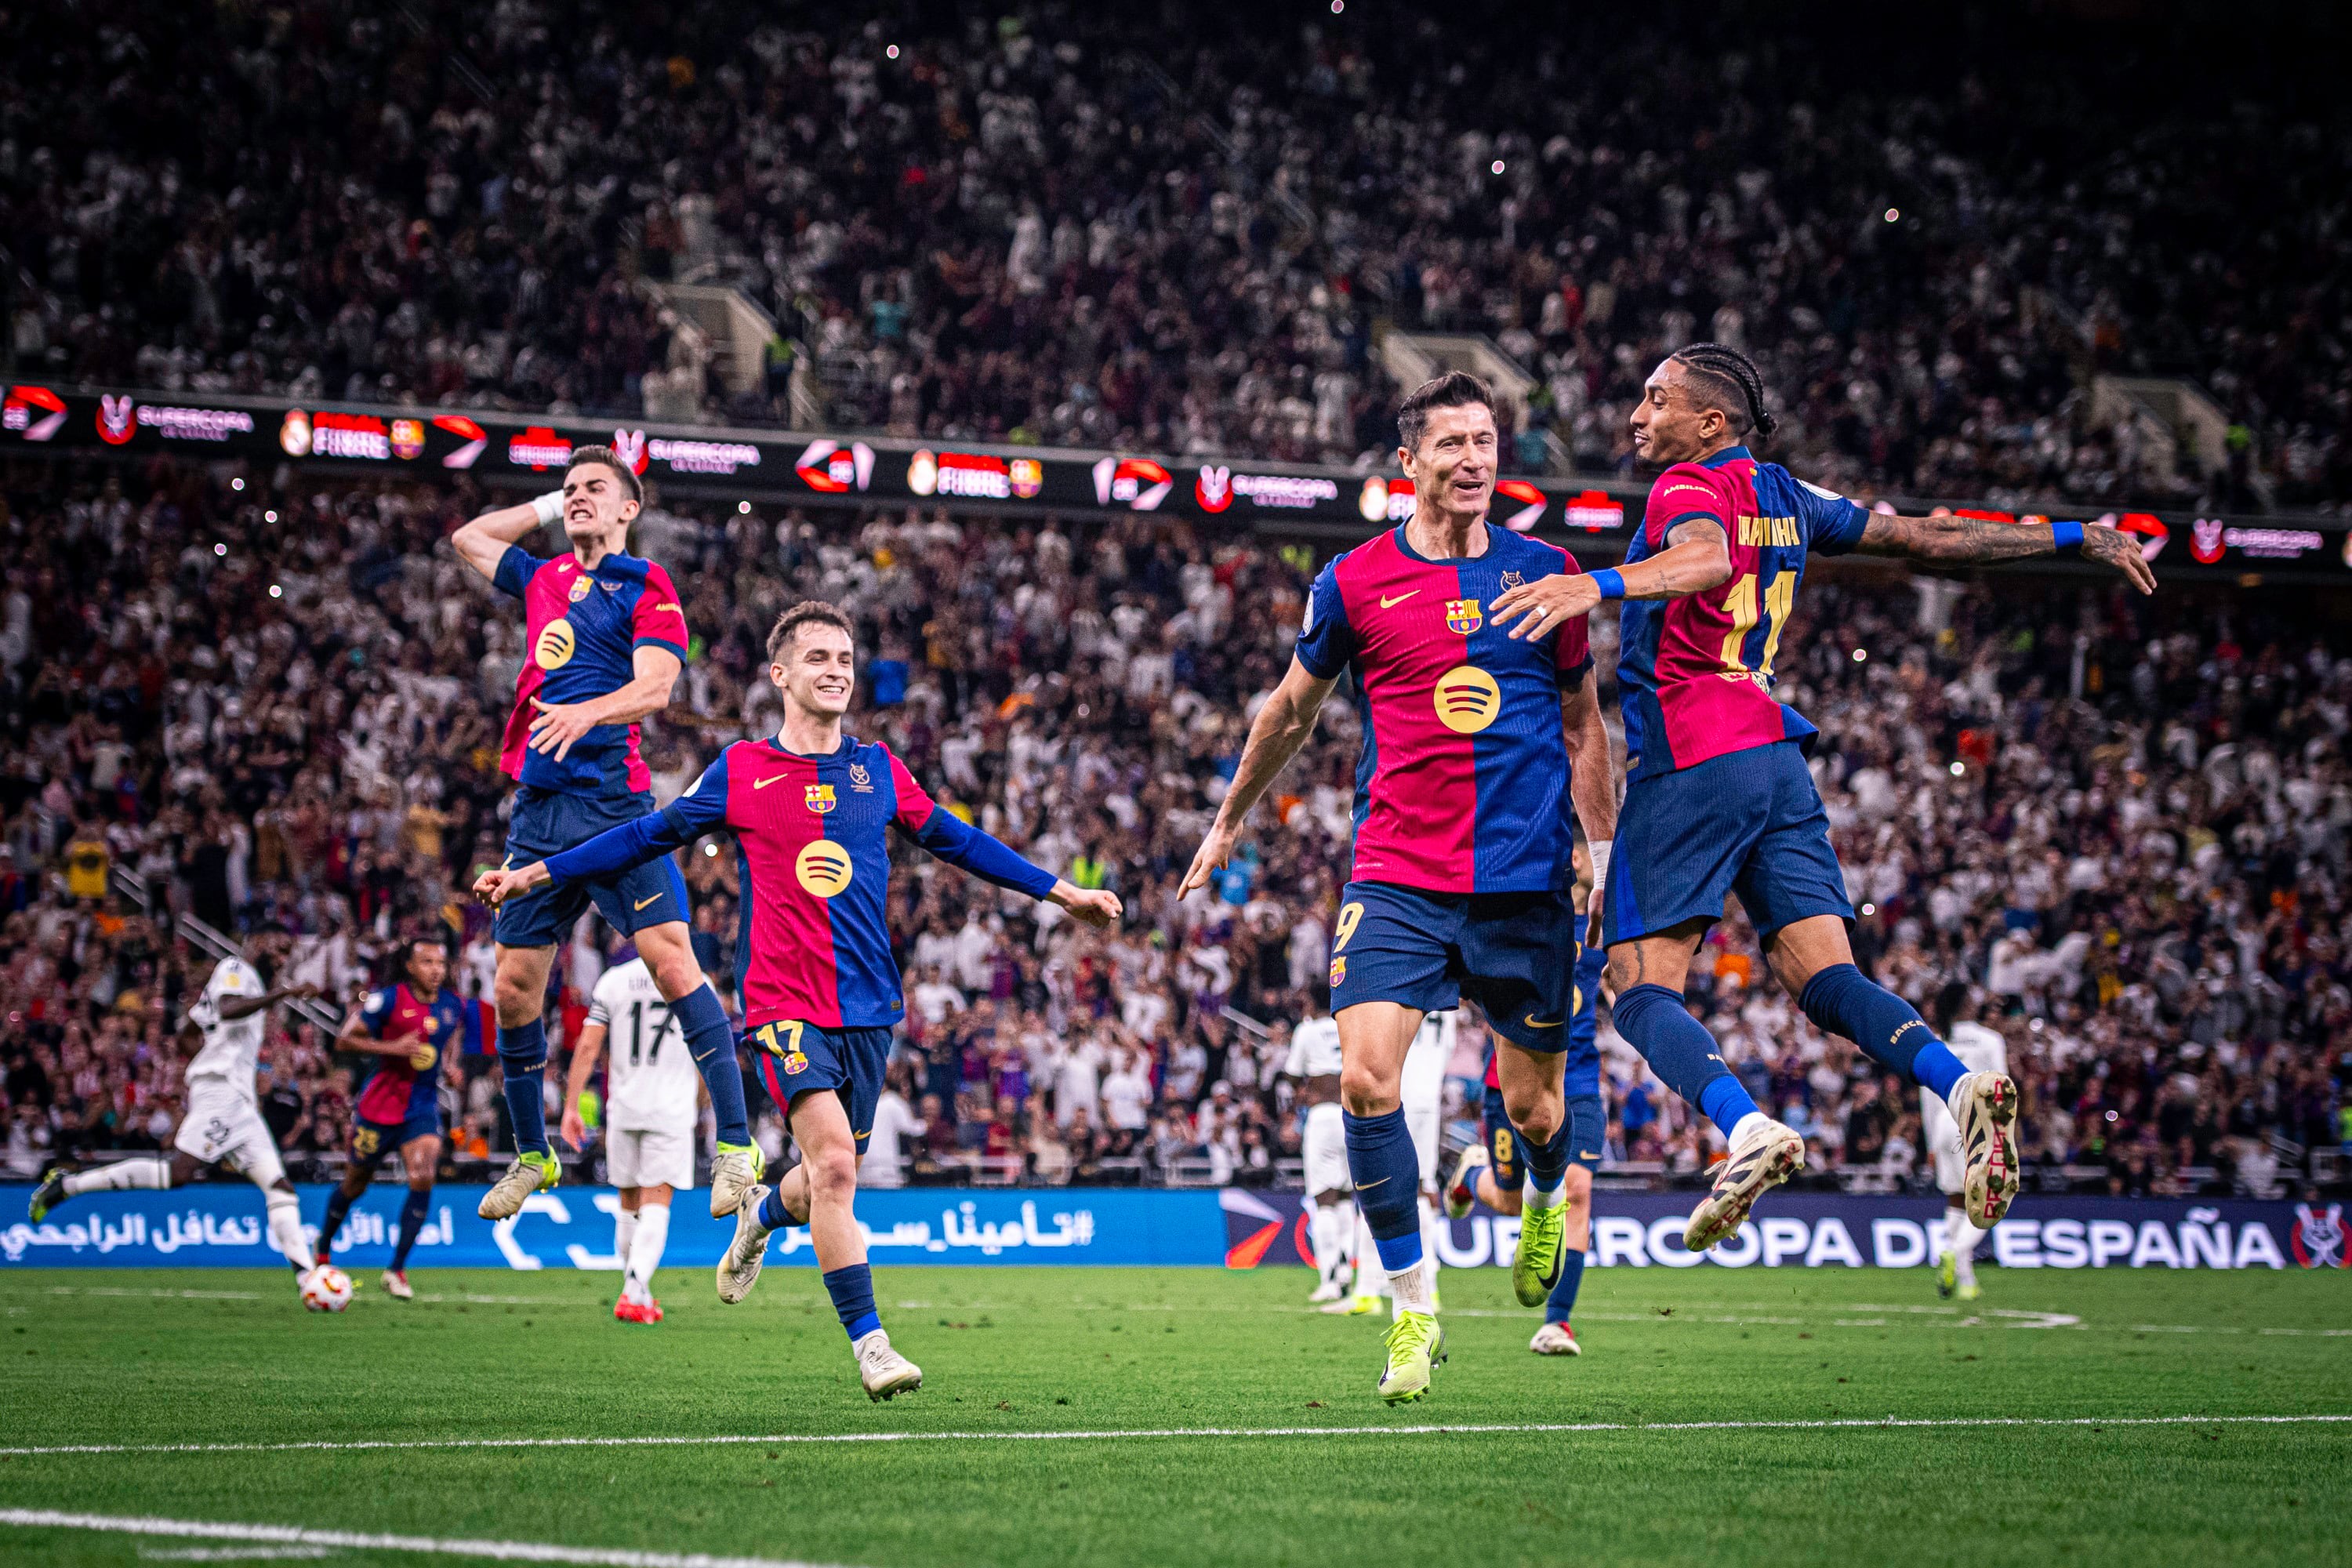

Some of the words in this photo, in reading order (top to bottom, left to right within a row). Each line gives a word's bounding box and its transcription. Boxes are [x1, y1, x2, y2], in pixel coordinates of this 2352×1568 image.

[1720, 571, 1797, 676] 11
[1334, 902, 1365, 953] 9
[630, 1000, 675, 1067] 17
[756, 1020, 804, 1060] 17
[1494, 1127, 1513, 1163] 8
[1435, 1216, 1864, 1269] UPRCOPA
[1991, 1207, 2285, 1271] ESPAÑA
